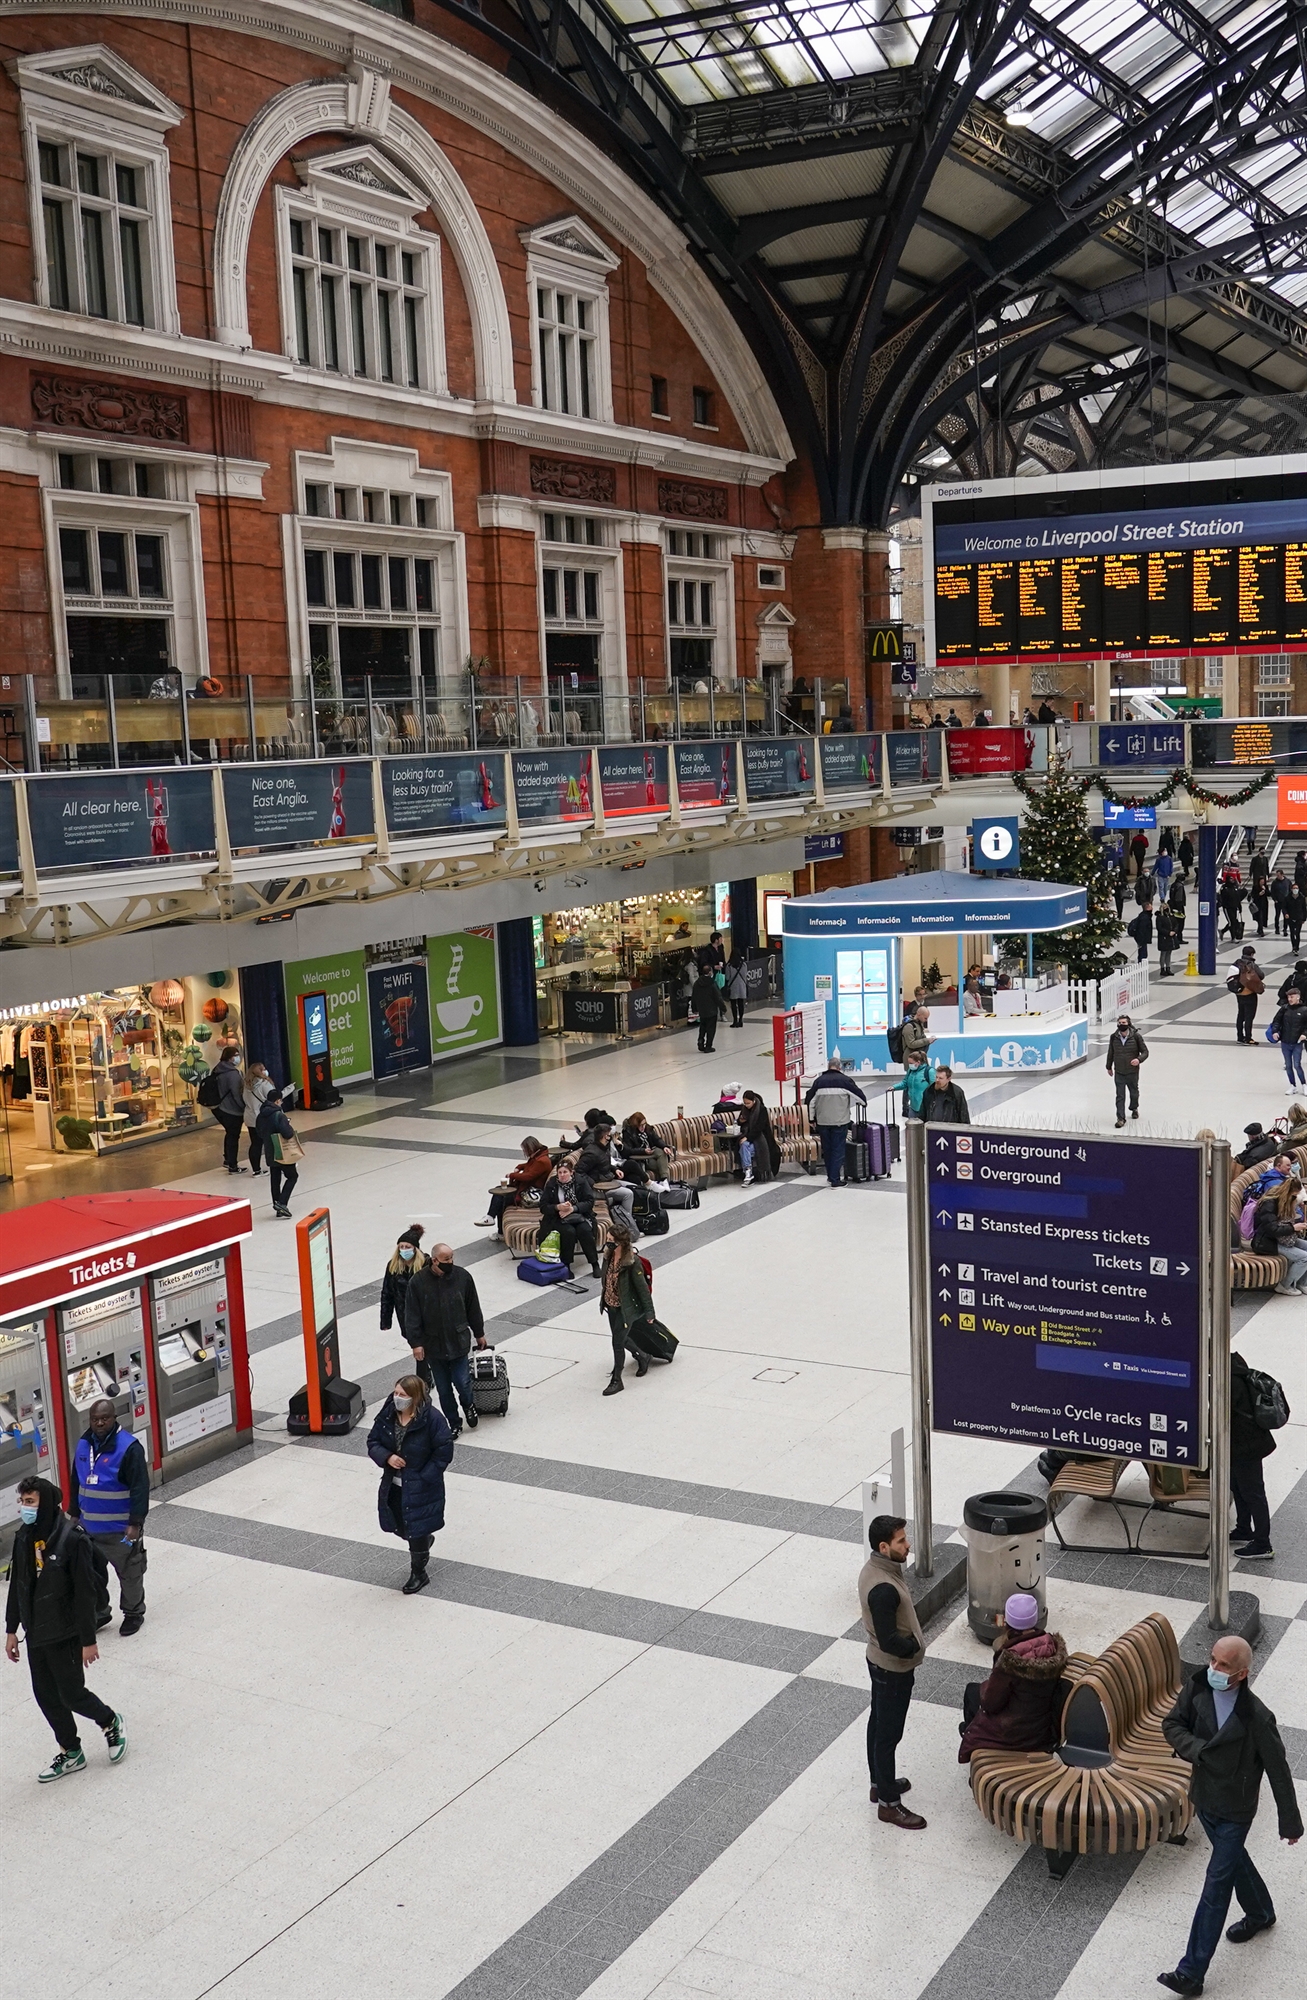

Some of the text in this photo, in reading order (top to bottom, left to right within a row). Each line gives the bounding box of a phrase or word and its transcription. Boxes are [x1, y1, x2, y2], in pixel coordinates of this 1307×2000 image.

[938, 486, 982, 497] Departures
[964, 519, 1244, 552] Welcome to Liverpool Street Station
[1116, 651, 1132, 659] East
[1154, 736, 1182, 751] Lift
[680, 752, 705, 762] Nice one,
[747, 748, 766, 759] Looking
[766, 748, 774, 756] for
[824, 755, 840, 764] added
[517, 761, 548, 772] Now with
[603, 765, 643, 776] All clear here.
[680, 764, 711, 776] East Anglia.
[747, 758, 783, 770] less busy train?
[392, 768, 444, 782] Looking for a
[517, 773, 568, 787] added sparkle.
[252, 778, 296, 790] Nice one,
[392, 781, 453, 796] less busy train?
[253, 792, 309, 808] East Anglia.
[62, 800, 142, 816] All clear here.
[809, 905, 1080, 926] Informacja Información Information Informazioni Information
[633, 951, 653, 959] SOHO
[302, 968, 350, 985] Welcome to
[392, 972, 412, 987] WiFi
[0, 995, 86, 1020] LIVER BONAS
[575, 1001, 604, 1013] SOHO
[634, 995, 652, 1010] SOHO
[578, 1015, 595, 1023] COFFEE
[341, 1043, 354, 1054] and
[334, 1056, 354, 1067] today
[980, 1140, 1069, 1160] Underground
[980, 1166, 1061, 1187] Overground
[981, 1217, 1150, 1246] Stansted Express tickets
[1093, 1254, 1142, 1271] Tickets
[69, 1256, 124, 1285] Tickets
[158, 1276, 180, 1288] Tickets
[182, 1270, 193, 1280] and
[194, 1264, 213, 1277] oyster
[981, 1268, 1147, 1298] Travel and tourist centre
[68, 1307, 92, 1319] Tickets
[94, 1300, 106, 1310] and
[107, 1294, 128, 1307] oyster
[982, 1294, 1004, 1308] Lift
[1008, 1301, 1022, 1312] Way
[1039, 1305, 1084, 1317] Underground
[1086, 1308, 1098, 1318] and
[1100, 1310, 1113, 1320] Bus
[1115, 1313, 1140, 1323] station
[982, 1318, 1036, 1337] Way out
[1048, 1330, 1074, 1338] Broadgate
[1011, 1403, 1142, 1427] By platform 10 Cycle racks
[954, 1419, 1142, 1452] Lost property by platform 10 Left Luggage
